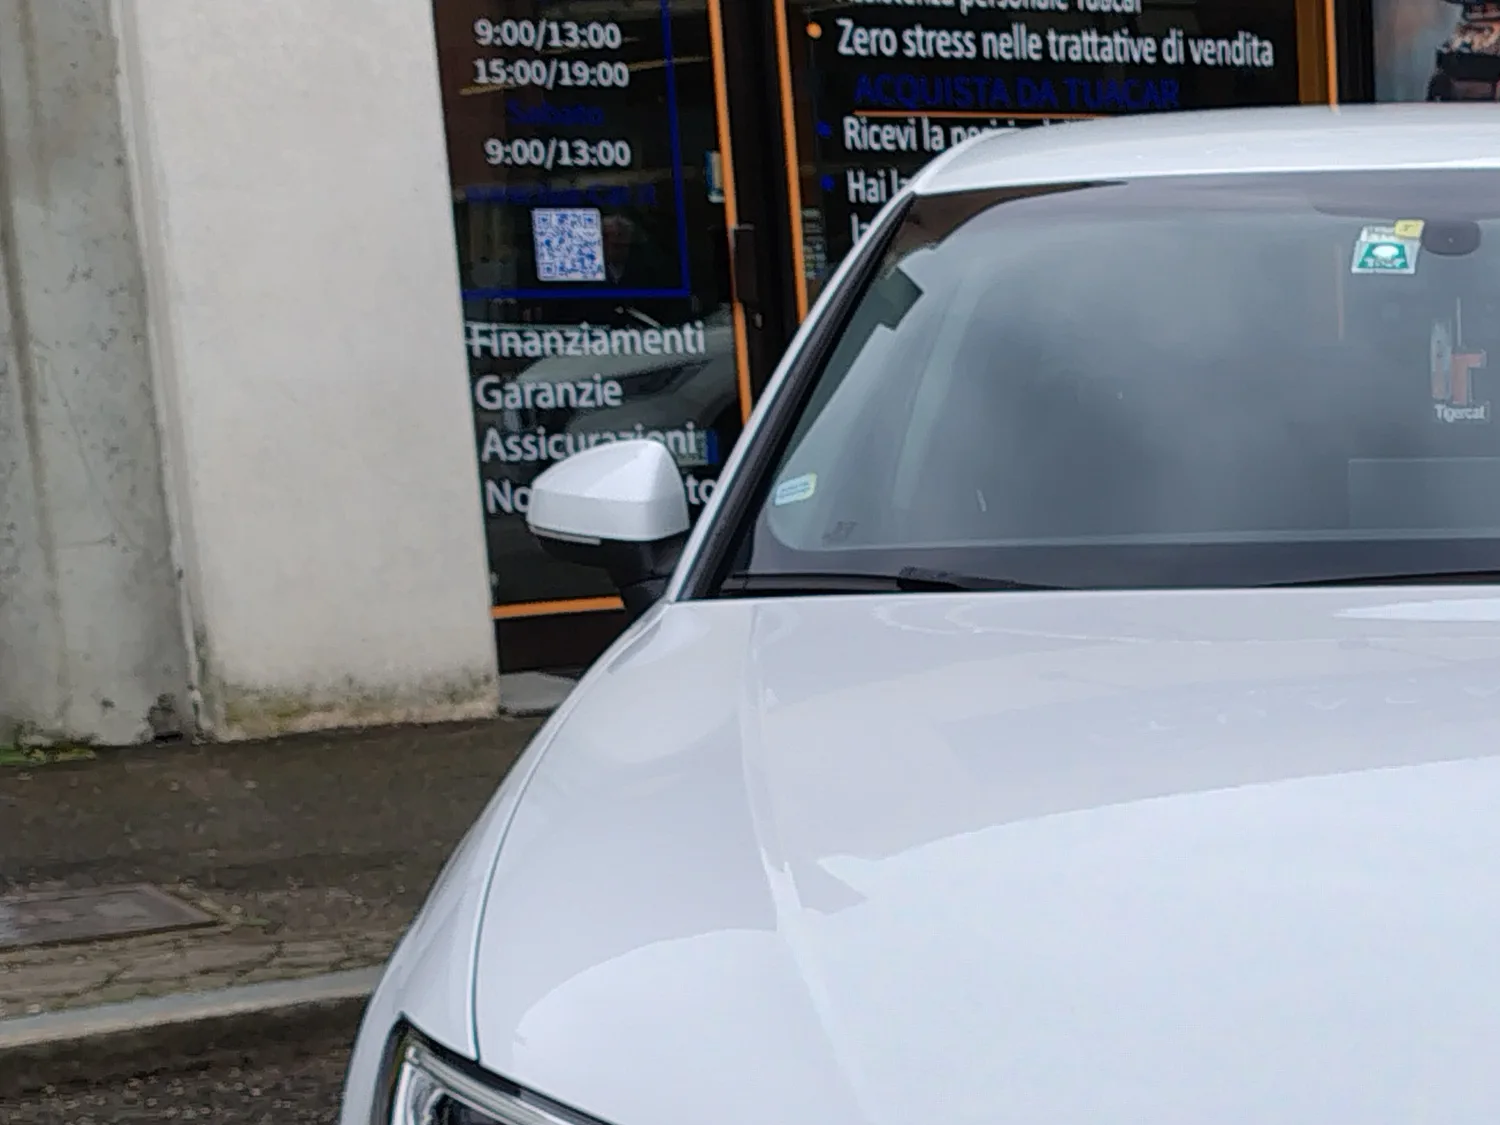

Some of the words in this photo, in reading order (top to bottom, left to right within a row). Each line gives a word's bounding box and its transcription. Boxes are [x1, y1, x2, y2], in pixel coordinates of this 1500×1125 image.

[474, 18, 622, 50] 9:00/13:00
[836, 18, 898, 57] Zero
[902, 23, 977, 60] stress
[982, 22, 1043, 62] nelle
[1047, 27, 1158, 65] trattative
[1162, 28, 1185, 65] di
[1190, 31, 1274, 67] vendita
[473, 58, 630, 90] 15:00/19:00
[853, 73, 1010, 110] ACQUISTA
[1017, 77, 1058, 109] DA
[1063, 77, 1180, 109] TUACAR
[843, 115, 917, 151] Ricevi
[922, 116, 945, 151] la
[484, 138, 632, 170] 9:00/13:00
[846, 167, 887, 203] Hai
[471, 321, 706, 358] Finanziamenti
[475, 373, 624, 411] Garanzie
